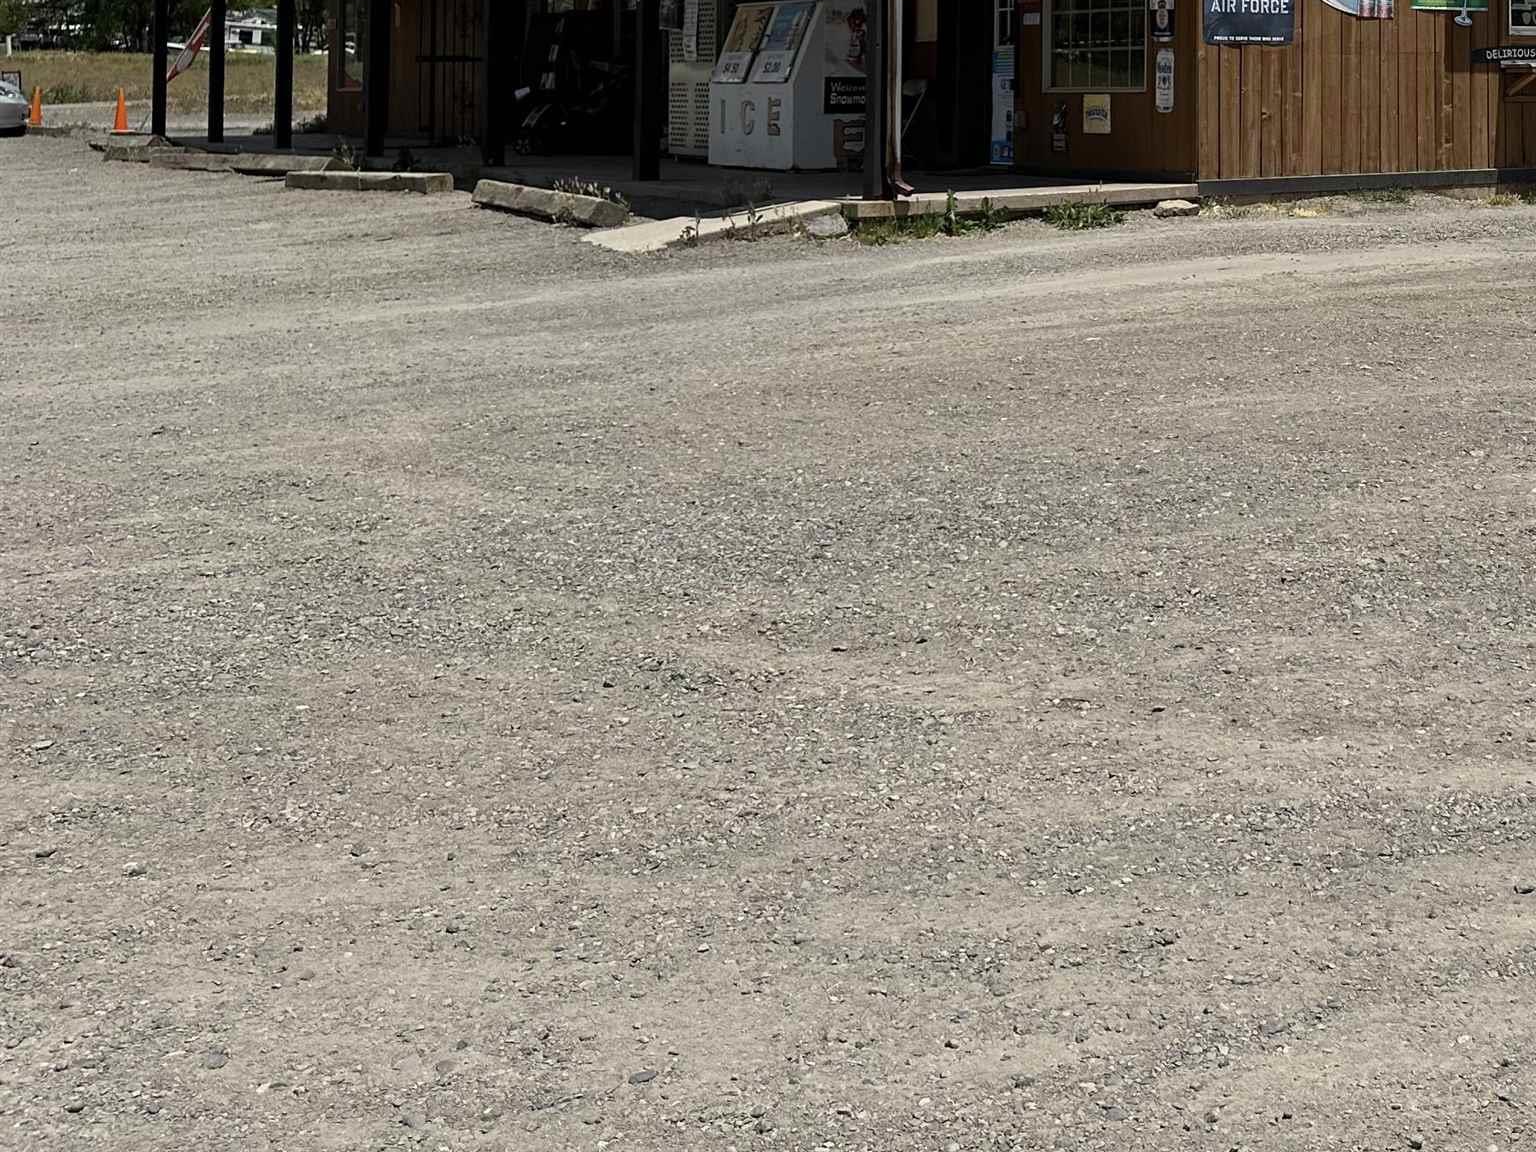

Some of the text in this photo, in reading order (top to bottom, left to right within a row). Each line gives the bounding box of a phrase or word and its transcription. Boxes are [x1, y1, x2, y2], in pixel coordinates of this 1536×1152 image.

[1485, 48, 1536, 60] DELIRIOUS
[830, 81, 866, 92] Welcom
[830, 93, 866, 105] Snowmo
[720, 97, 781, 137] ICE
